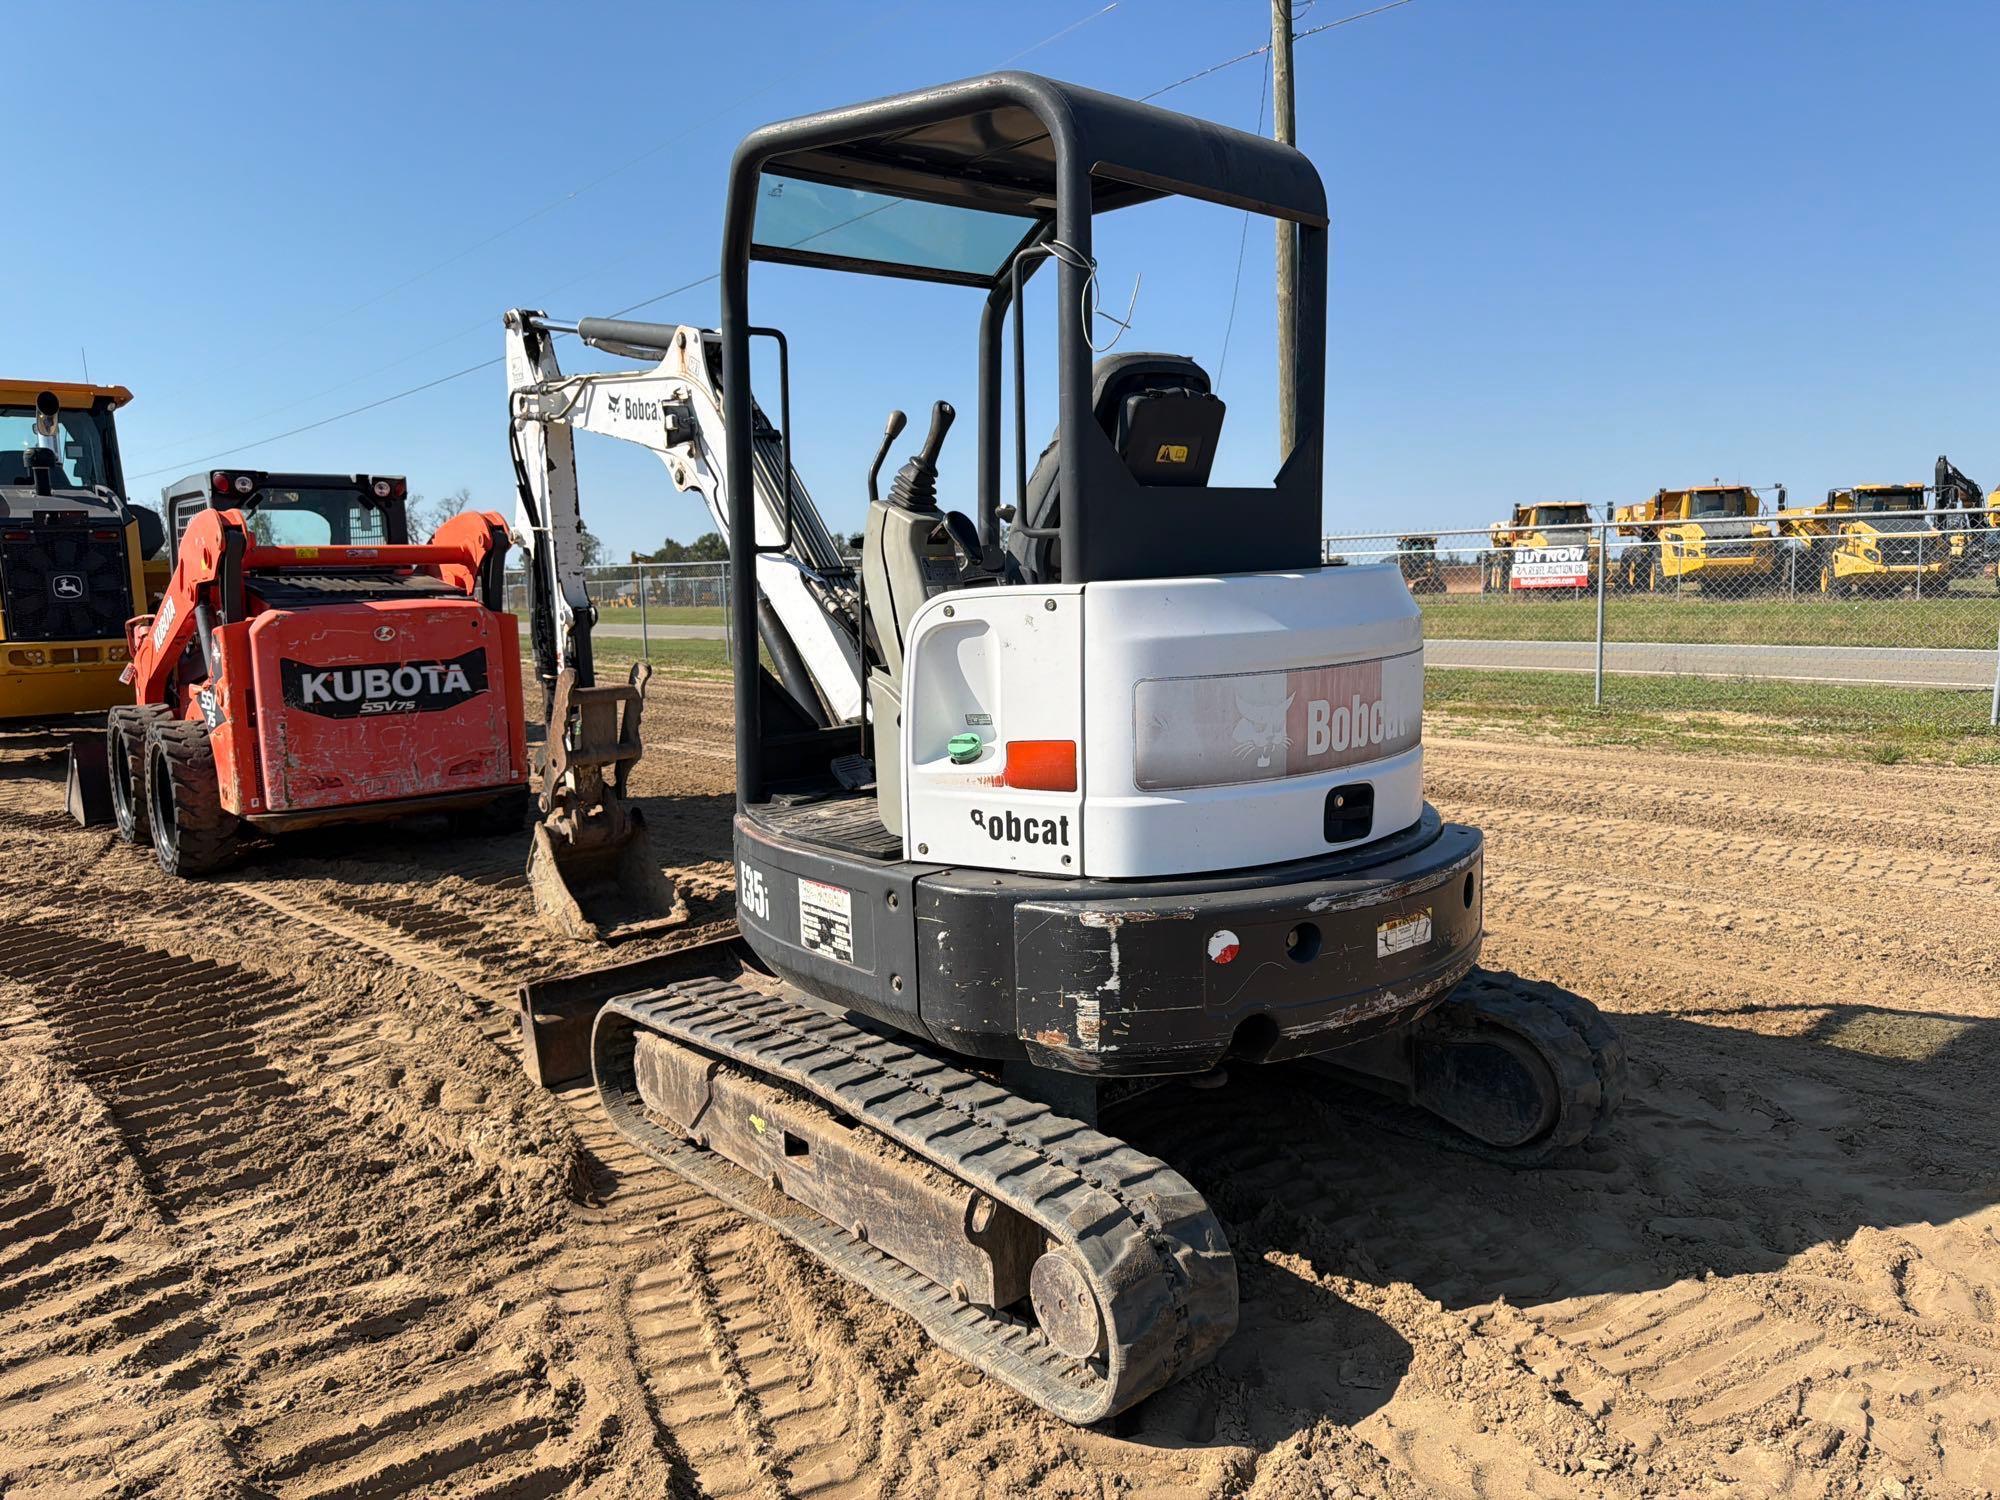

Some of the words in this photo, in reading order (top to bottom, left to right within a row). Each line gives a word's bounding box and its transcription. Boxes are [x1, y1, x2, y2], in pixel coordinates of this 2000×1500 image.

[1515, 550, 1542, 564] BUY
[1545, 548, 1585, 562] NOW
[1547, 564, 1573, 575] AUCTION
[154, 595, 176, 653] KUBOTA
[302, 664, 473, 704] KUBOTA
[201, 690, 217, 711] SSV
[207, 710, 216, 728] 75
